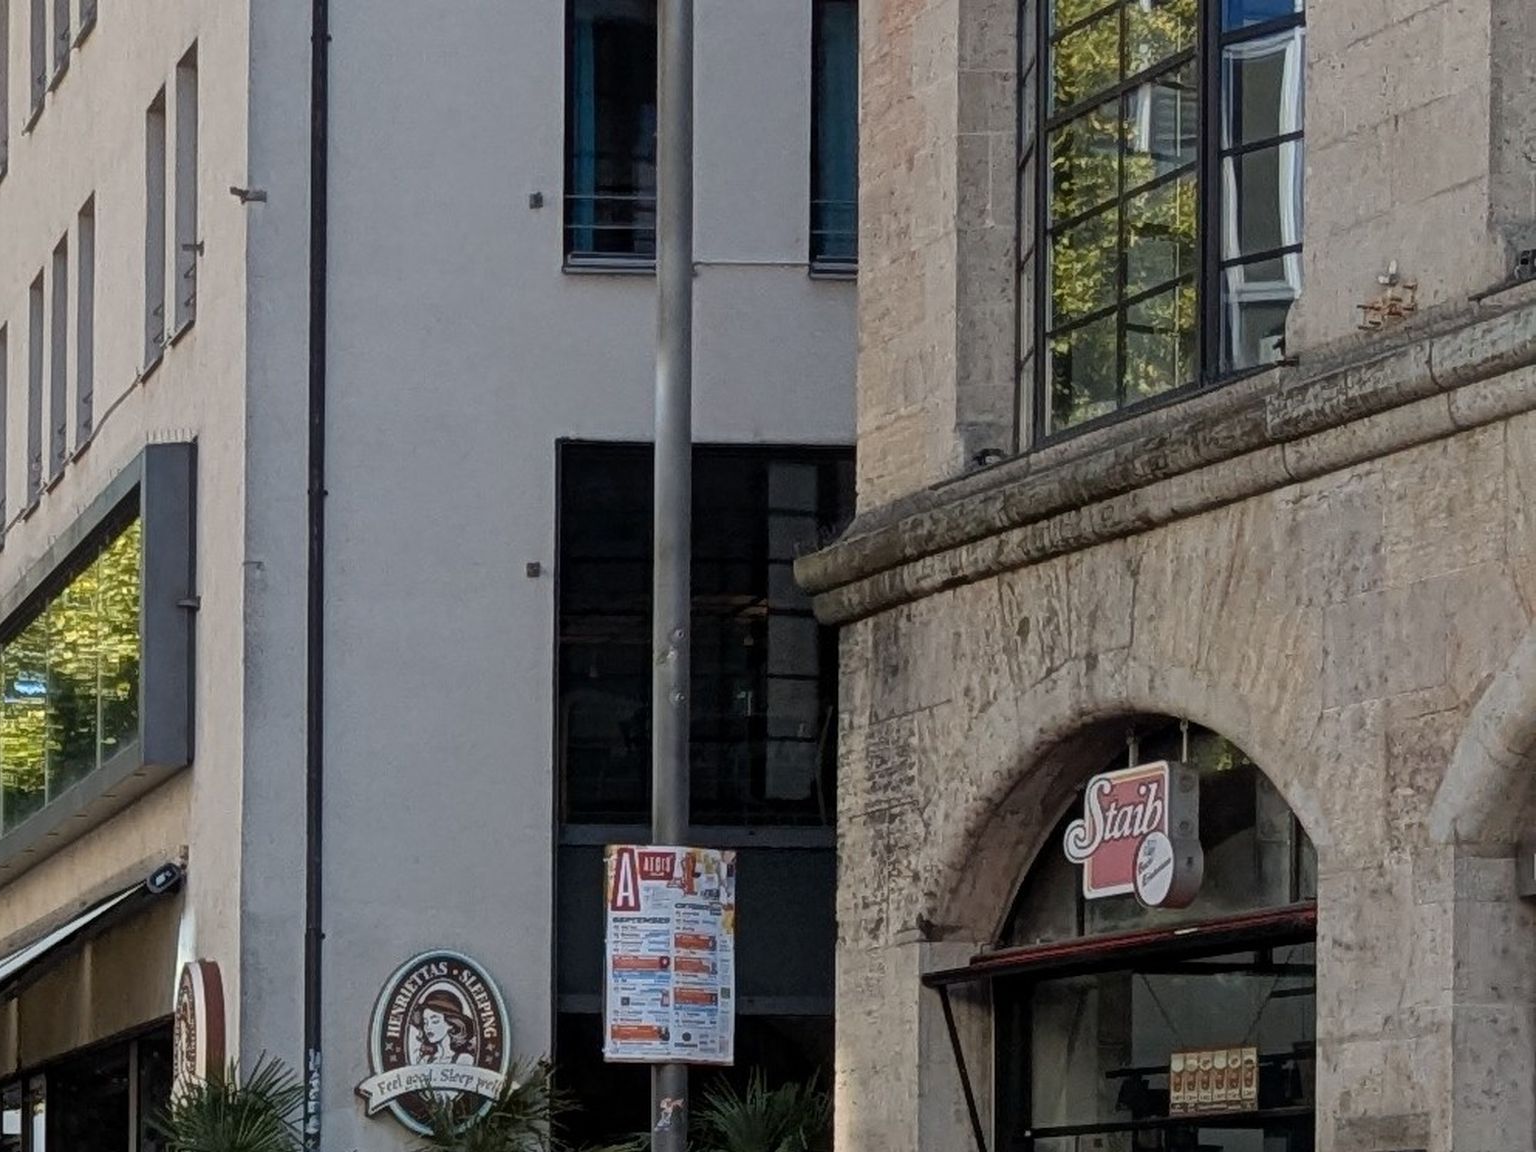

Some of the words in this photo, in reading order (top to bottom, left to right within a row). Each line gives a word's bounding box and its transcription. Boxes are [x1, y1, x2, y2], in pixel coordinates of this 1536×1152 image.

[1064, 778, 1166, 863] Staib
[616, 852, 635, 907] A
[386, 961, 448, 1038] HENRIETTAS
[458, 969, 498, 1039] SLEEPING
[377, 1074, 403, 1096] Feel
[439, 1068, 474, 1087] Sleep
